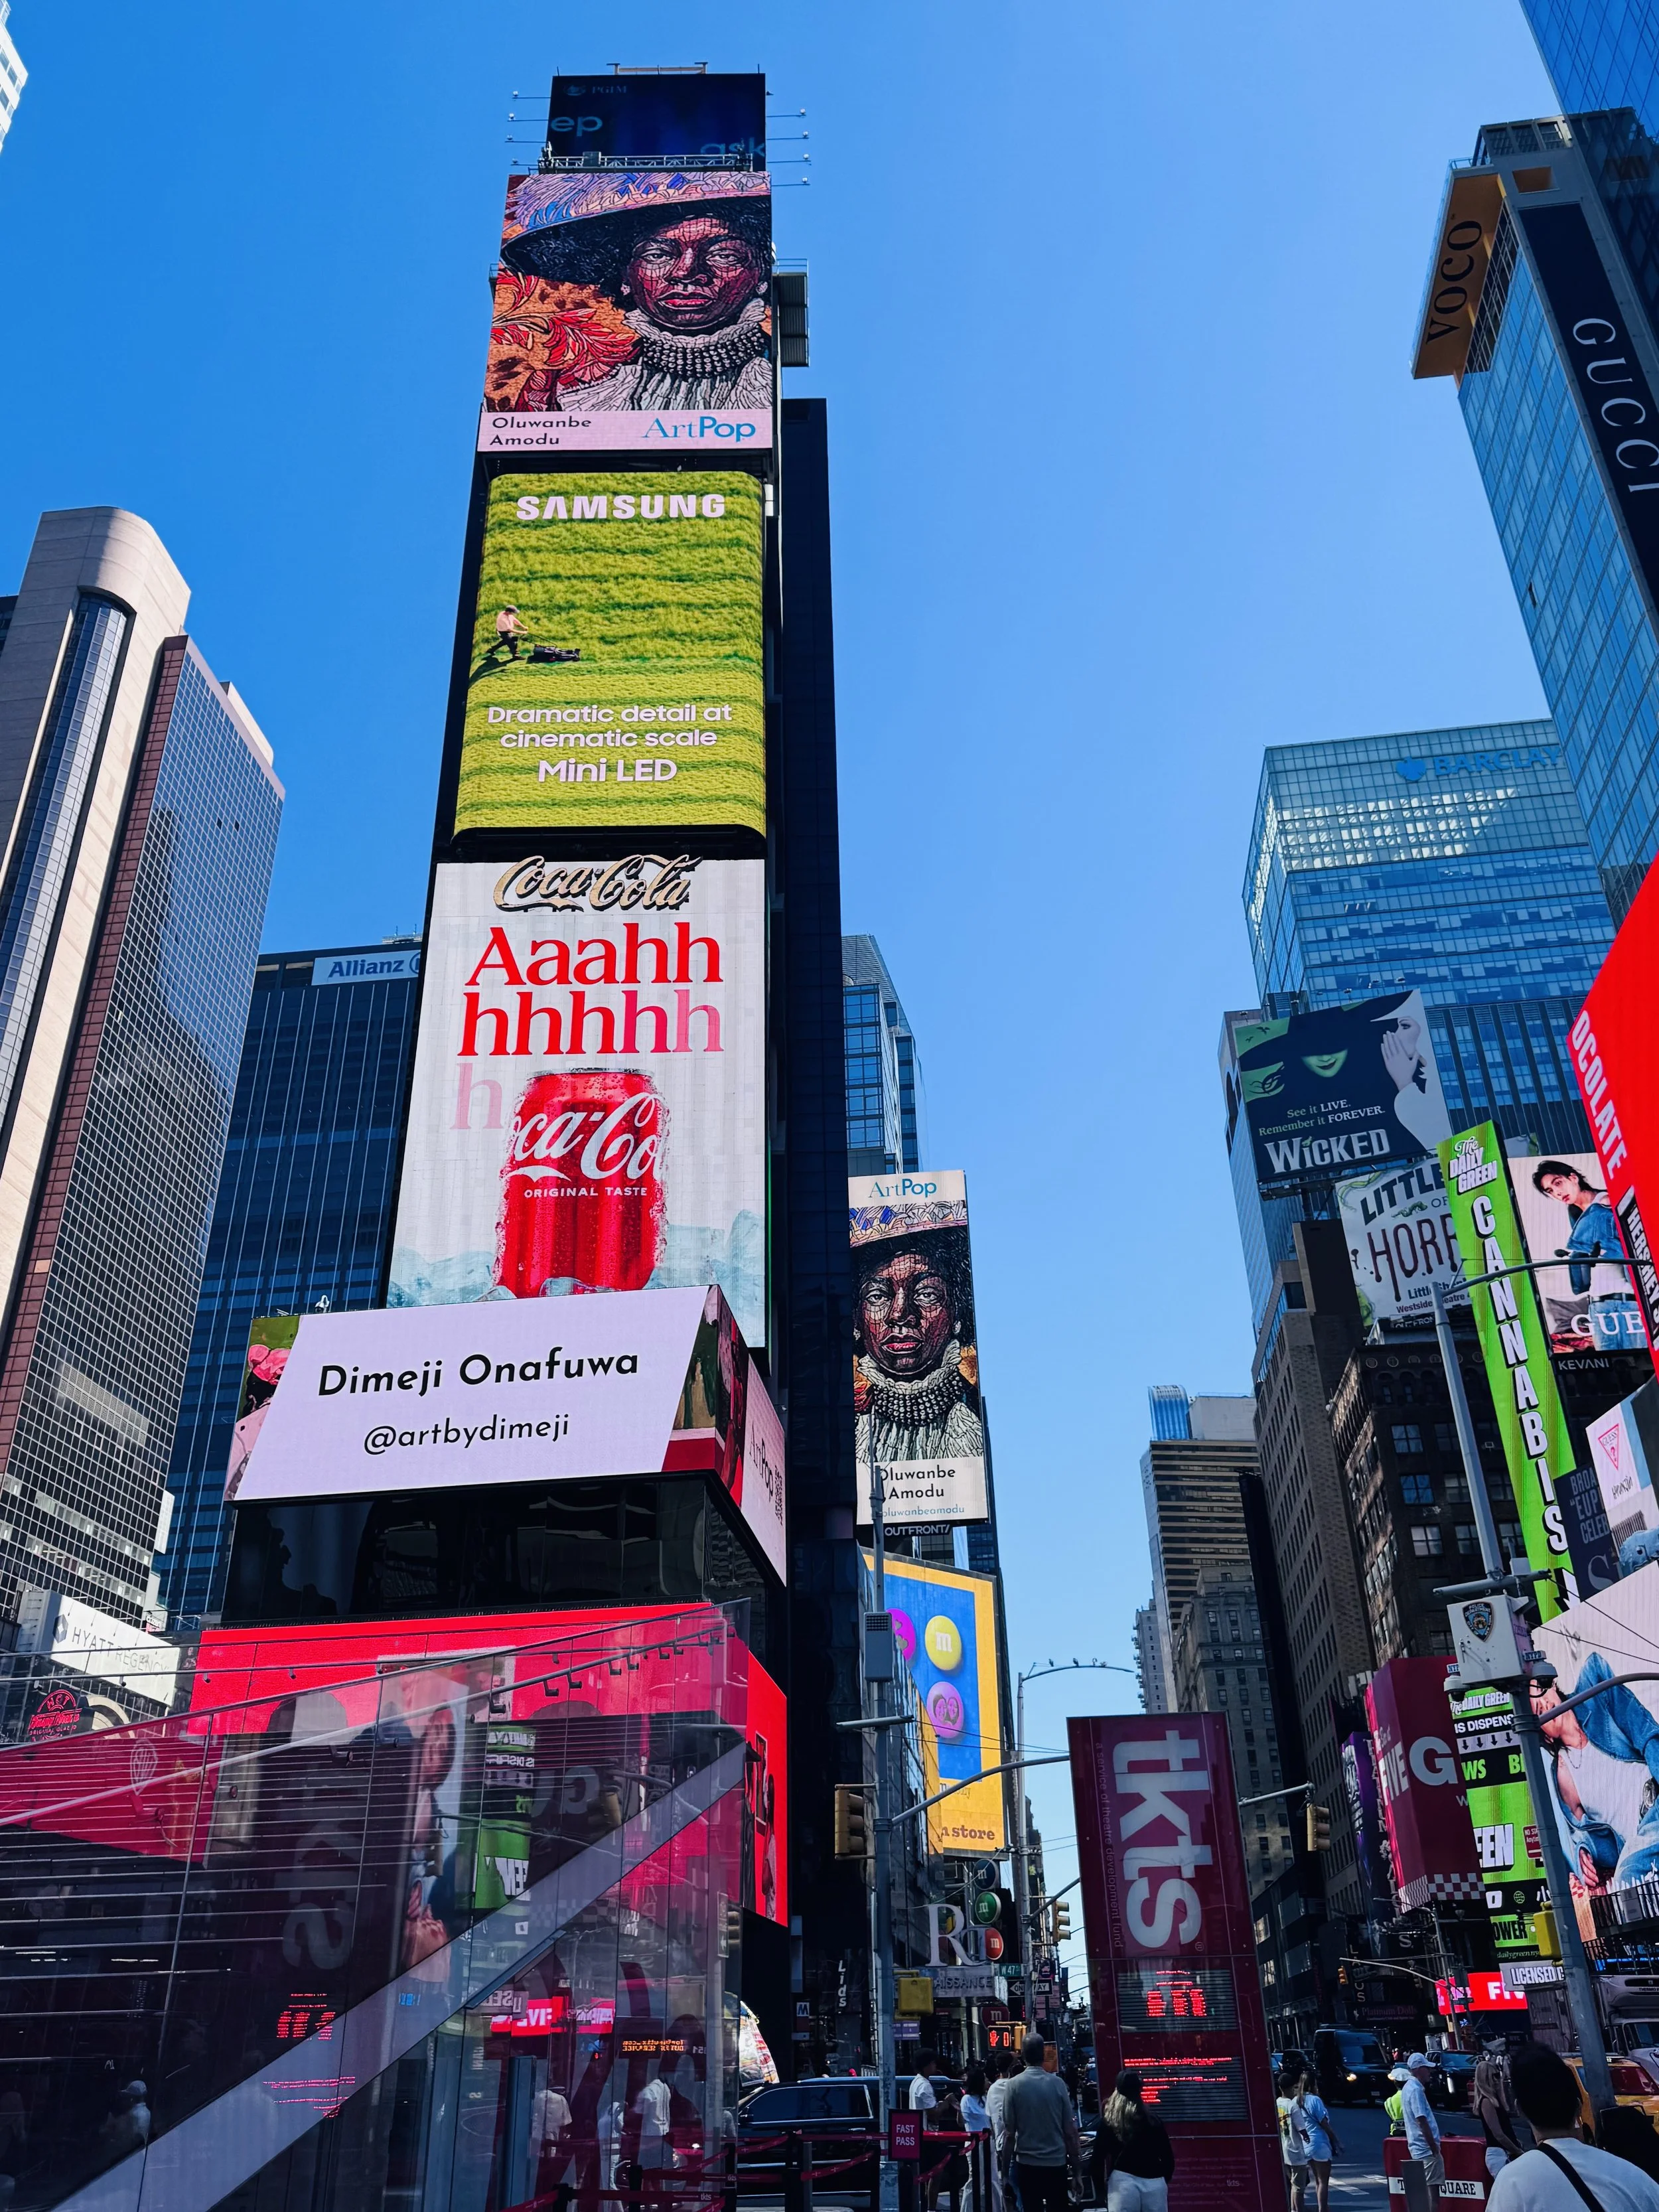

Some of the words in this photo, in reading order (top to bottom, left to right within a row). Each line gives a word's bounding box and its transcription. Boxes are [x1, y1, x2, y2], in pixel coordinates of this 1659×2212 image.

[1573, 317, 1659, 494] GUCCI
[492, 416, 592, 429] Oluwanbe
[642, 416, 756, 442] ArtPop
[490, 433, 560, 447] Amodu
[517, 494, 725, 520] SAMSUNG
[488, 705, 614, 723] Dramatic
[621, 703, 696, 722] detail
[703, 705, 733, 721] at
[500, 729, 638, 748] cinematic
[644, 729, 717, 747] scale
[538, 759, 607, 782] Mini
[617, 759, 678, 782] LED
[465, 922, 724, 986] Aaahh
[328, 958, 405, 978] Allianz
[457, 989, 724, 1056] hhhhh
[1287, 1108, 1307, 1118] See
[1309, 1105, 1317, 1114] it
[1321, 1099, 1351, 1112] LIVE.
[1259, 1119, 1315, 1136] Remember
[1317, 1116, 1325, 1125] it
[1328, 1105, 1386, 1123] FOREVER.
[1454, 1136, 1479, 1157] The
[1449, 1147, 1484, 1179] DAILY
[1458, 1160, 1497, 1193] GREEN
[524, 1187, 599, 1198] ORIGINAL
[605, 1187, 648, 1196] TASTE
[868, 1179, 937, 1198] ArtPop
[1360, 1163, 1445, 1226] LITTLE
[1396, 1300, 1433, 1313] Westside
[319, 1361, 443, 1398] Dimeji
[459, 1346, 639, 1386] Onafuwa
[1473, 1195, 1568, 1552] CANNABIS
[1558, 1357, 1609, 1370] KEVANI
[363, 1414, 570, 1455] @artbydimeji
[1602, 1430, 1618, 1447] GUESS
[889, 1483, 944, 1500] Amodu
[72, 1626, 114, 1657] HYATT
[1526, 1651, 1542, 1659] NYPD
[1462, 1694, 1484, 1711] DAILY
[1484, 1692, 1510, 1707] GREEN
[952, 1824, 995, 1840] store
[1112, 1730, 1213, 1949] tkts
[1104, 1847, 1120, 1910] development
[1007, 1965, 1015, 1976] 47
[1511, 1966, 1556, 1985] LICENSED
[837, 1960, 847, 2007] Lids
[896, 2125, 914, 2134] FAST
[895, 2137, 915, 2146] PASS
